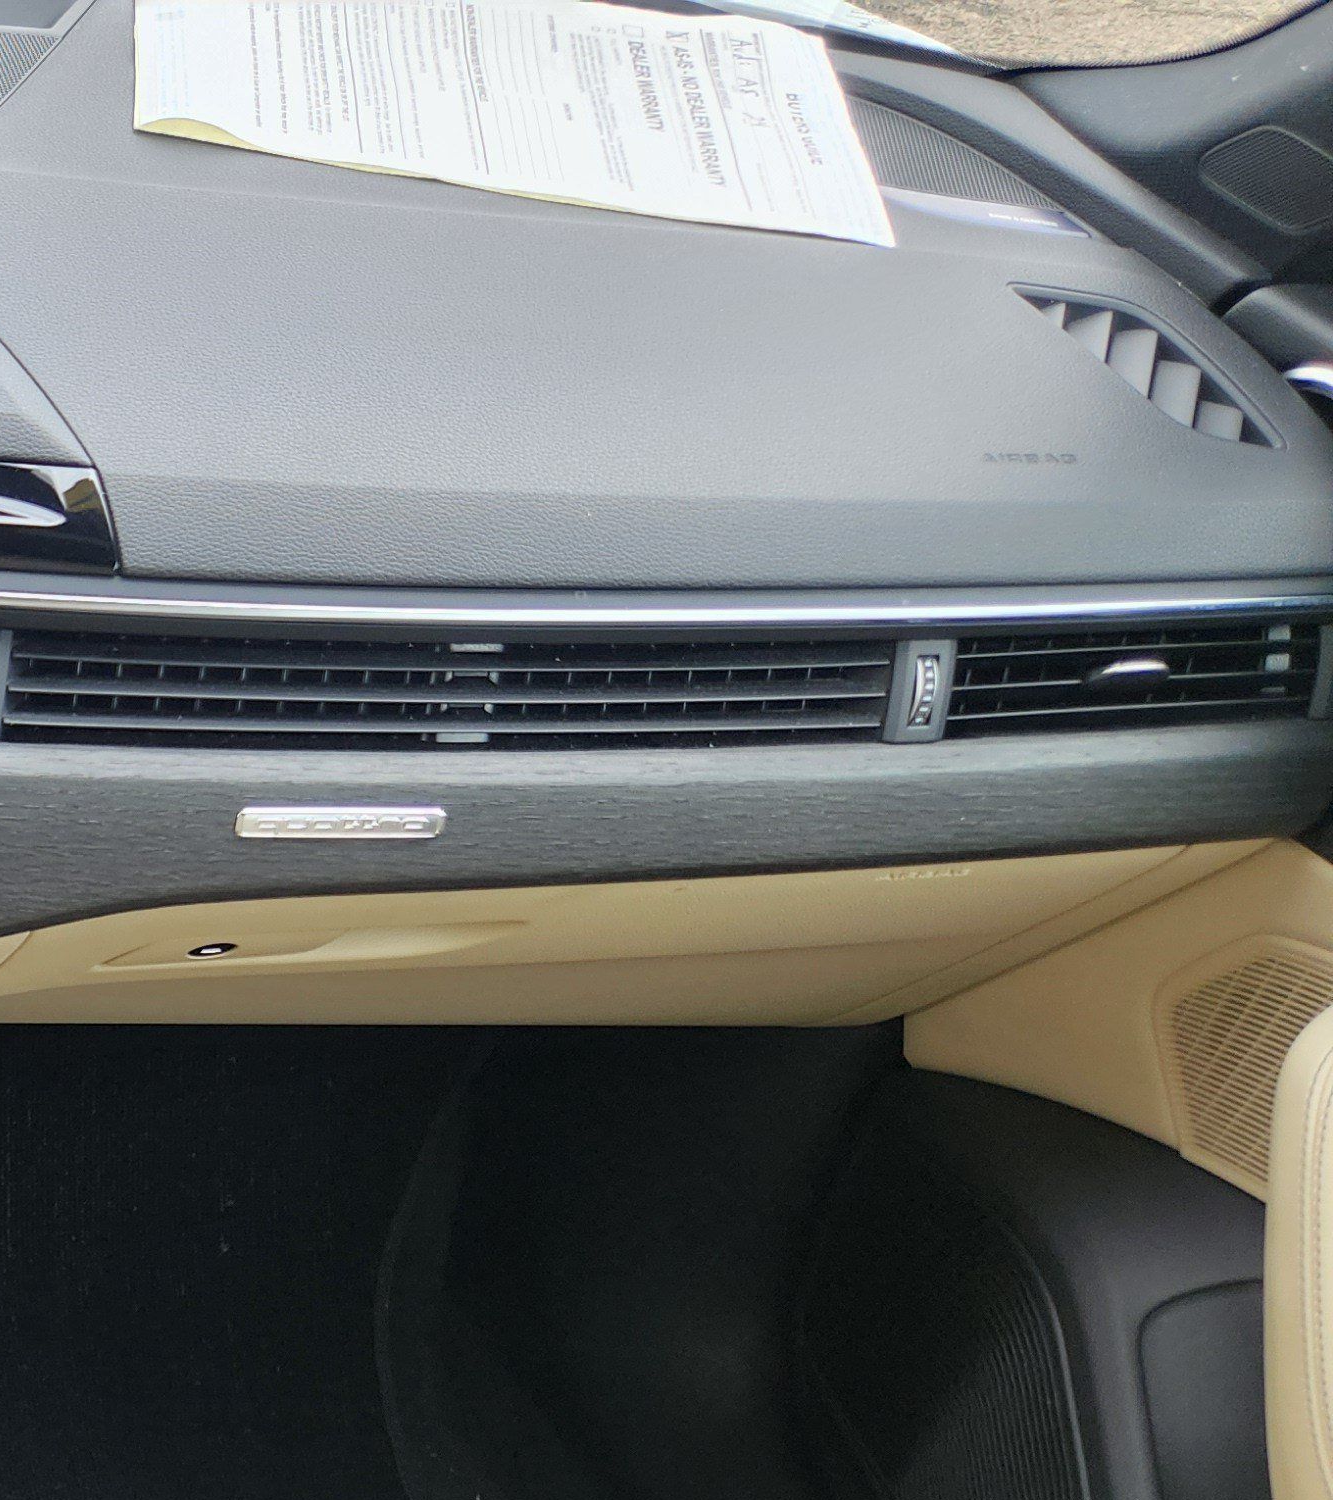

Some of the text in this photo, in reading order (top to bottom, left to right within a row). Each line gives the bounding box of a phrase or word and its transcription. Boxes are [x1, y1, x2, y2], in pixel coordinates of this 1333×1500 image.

[628, 41, 651, 79] DEALER
[673, 46, 694, 70] AS-IS
[680, 76, 699, 91] NO
[636, 80, 666, 133] WARRANTY
[683, 92, 711, 130] DEALER
[695, 131, 727, 187] WARRANTY
